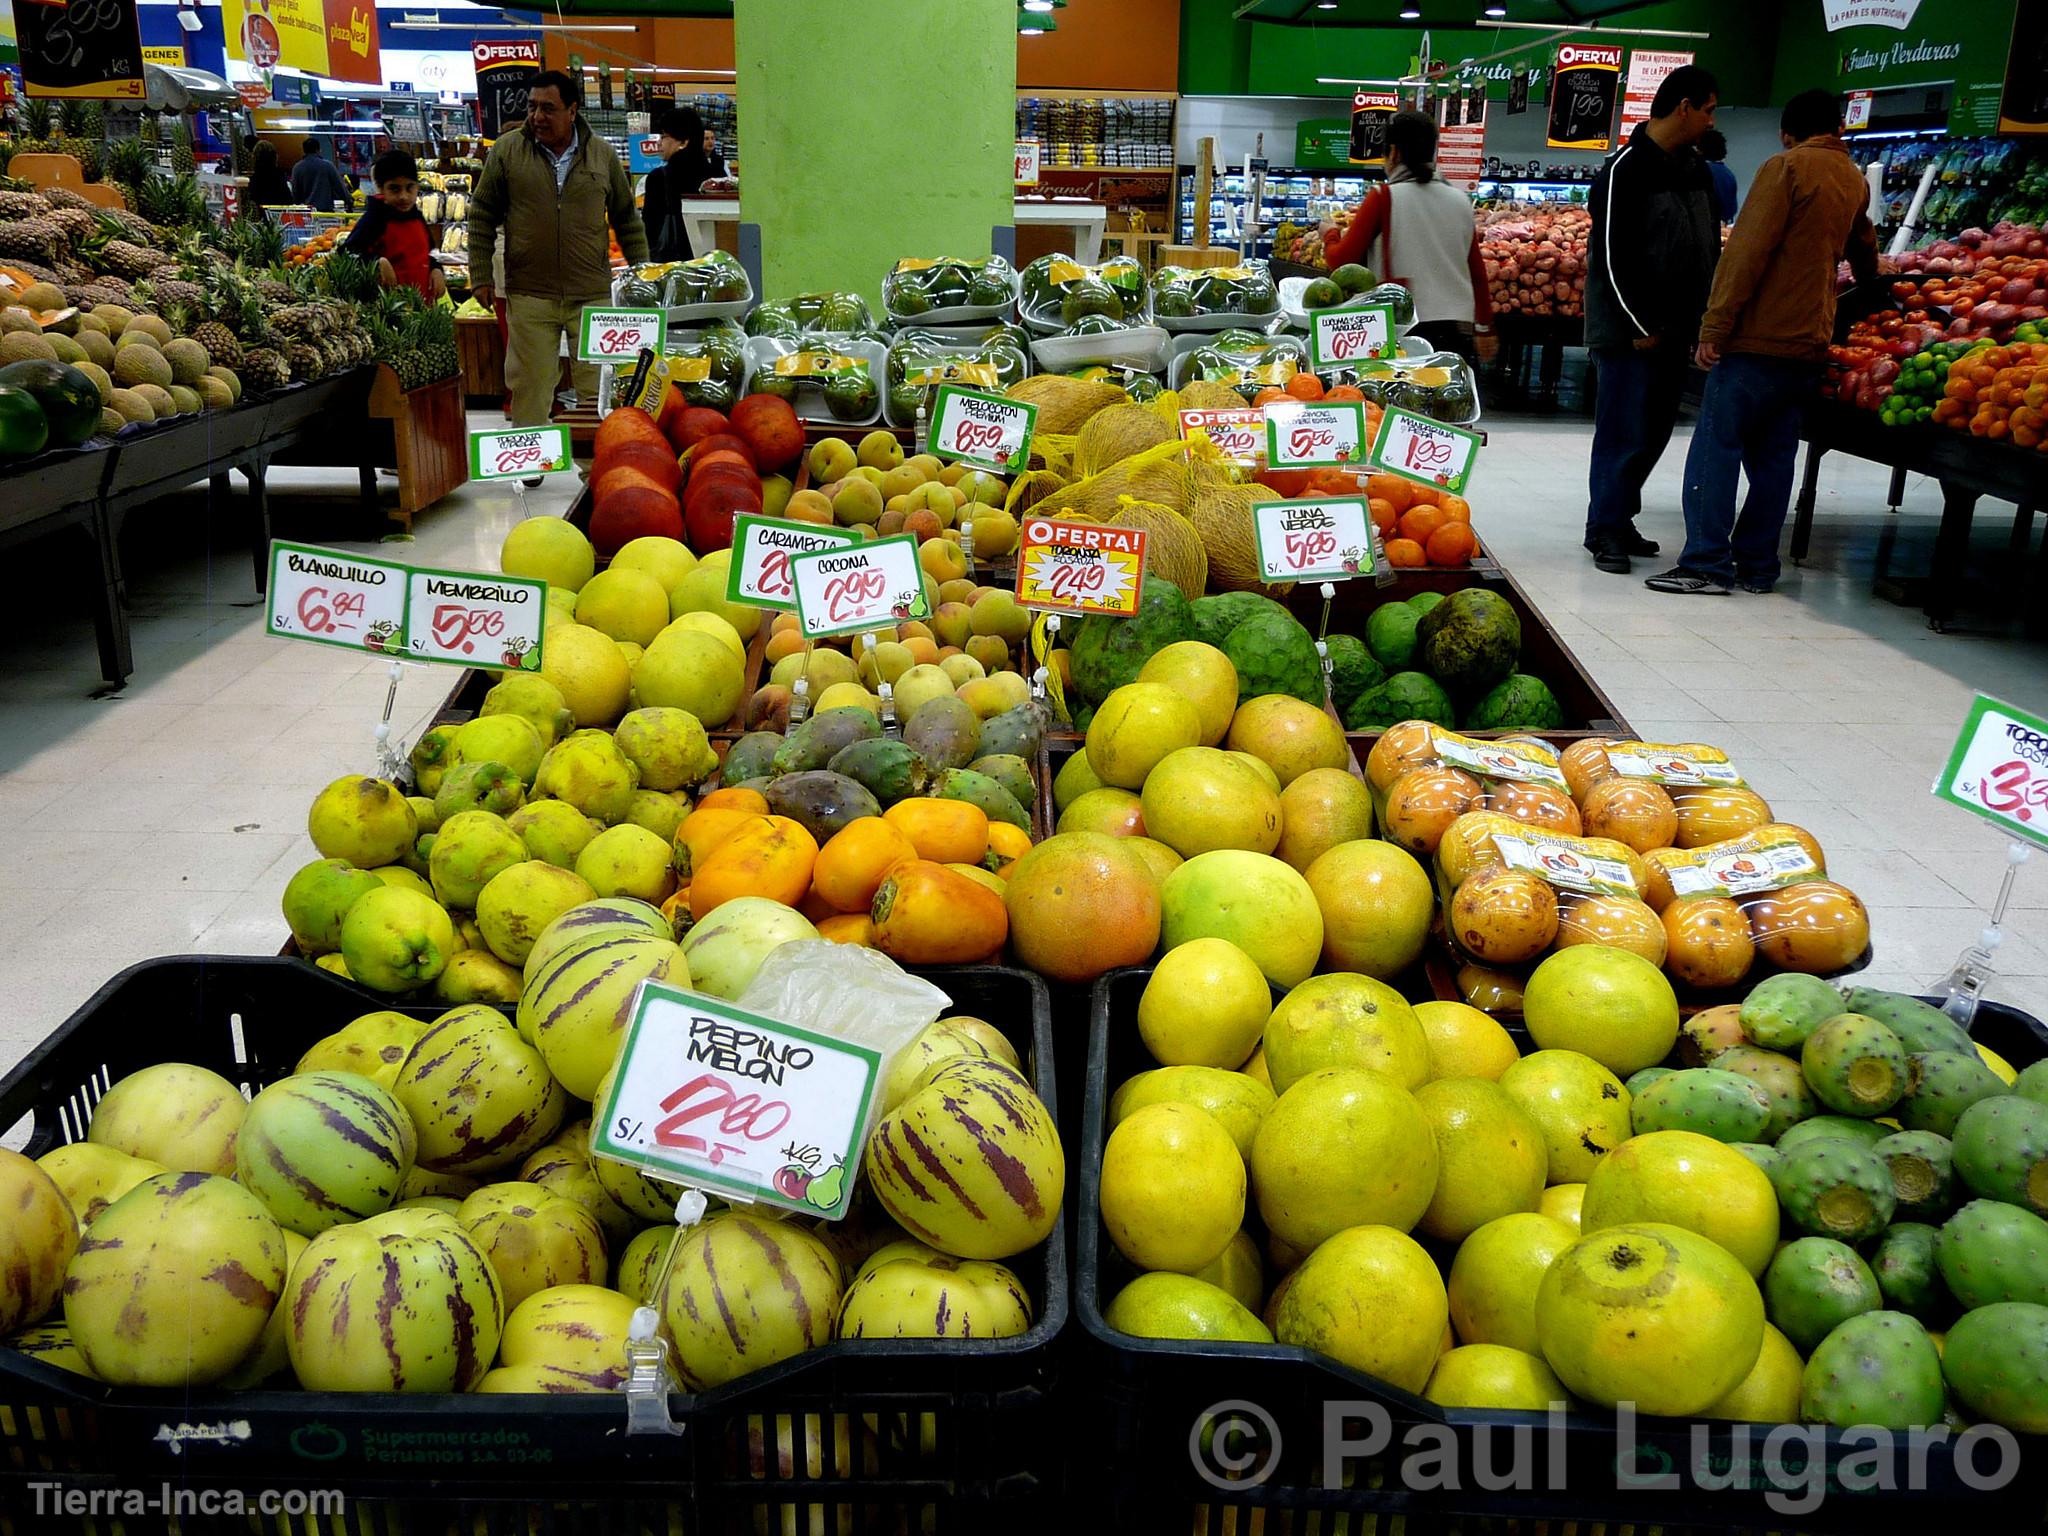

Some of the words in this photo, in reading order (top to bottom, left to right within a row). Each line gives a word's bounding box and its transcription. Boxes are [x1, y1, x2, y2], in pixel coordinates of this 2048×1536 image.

[1841, 9, 1859, 21] PAPA
[1860, 8, 1870, 17] ES
[142, 51, 179, 59] GENES
[474, 44, 537, 61] OFERTA!
[1559, 47, 1621, 66] OFERTA!
[1847, 48, 1879, 73] Frutas
[1879, 51, 1889, 72] y
[1892, 39, 1961, 65] Verduras
[1455, 57, 1514, 82] Fruta
[395, 83, 406, 92] 27
[1355, 94, 1399, 107] OFERTA!
[959, 397, 1018, 418] MELOCOTON
[965, 408, 1005, 424] PREMIUM
[1281, 507, 1325, 520] TUNA
[1280, 517, 1336, 531] VERDE
[1028, 521, 1140, 552] OFERTA!
[1049, 545, 1101, 560] TORONJA
[288, 553, 387, 586] BLANQUILLO
[817, 554, 869, 576] COCONA
[1266, 562, 1283, 574] S/.
[427, 578, 529, 604] MEMBRILLO
[275, 614, 293, 630] S/.
[808, 618, 826, 631] S/.
[411, 638, 429, 652] S/.
[1960, 781, 1978, 797] S/.
[689, 1016, 814, 1071] PEPINO
[686, 1039, 785, 1087] MELON
[613, 1117, 645, 1145] S/.
[362, 1427, 531, 1446] Supermercados
[364, 1446, 464, 1463] Peruanos
